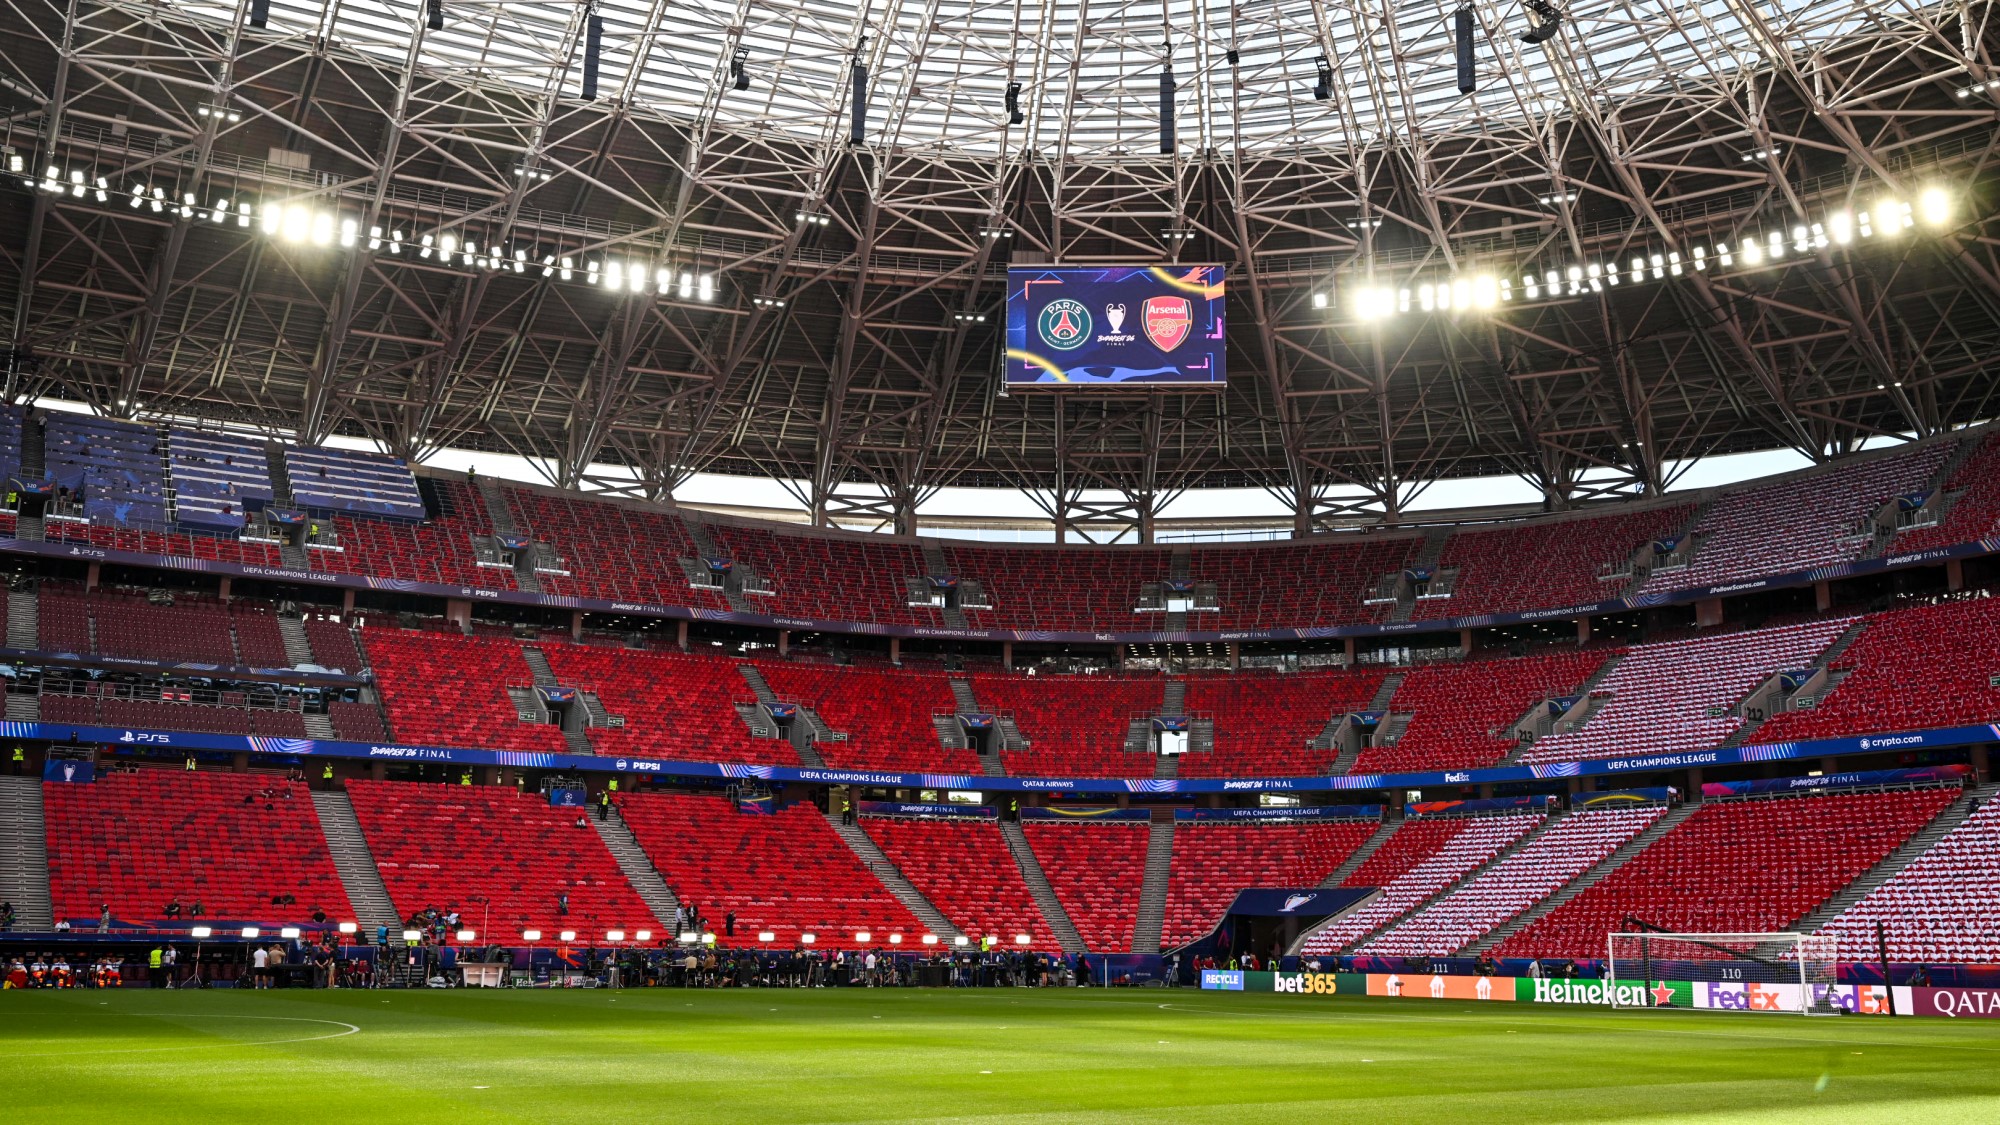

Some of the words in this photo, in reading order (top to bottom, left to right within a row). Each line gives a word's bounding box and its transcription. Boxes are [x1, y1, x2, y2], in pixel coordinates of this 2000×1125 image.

[1047, 302, 1082, 314] PARIS
[1149, 305, 1185, 314] Arsenal
[1924, 550, 1950, 559] FINAL
[264, 569, 308, 579] CHAMPIONS
[309, 573, 336, 581] LEAGUE
[1539, 608, 1573, 617] CHAMPIONS
[137, 734, 169, 742] PS5
[1519, 730, 1533, 743] 213
[1872, 735, 1923, 748] crypto.com
[420, 750, 455, 759] FINAL
[633, 762, 660, 770] PEPSI
[1608, 761, 1629, 769] UEFA
[1631, 756, 1681, 767] CHAMPIONS
[1683, 753, 1716, 763] LEAGUE
[822, 772, 869, 781] CHAMPIONS
[871, 775, 901, 783] LEAGUE
[1445, 773, 1469, 782] FedEx
[1832, 775, 1860, 783] FINAL
[1434, 964, 1448, 972] 111
[1722, 968, 1741, 979] 110
[1206, 974, 1238, 984] RECYCLE
[1275, 972, 1336, 994] bet365
[1533, 978, 1647, 1006] Heineken
[1708, 982, 1781, 1011] FedEx
